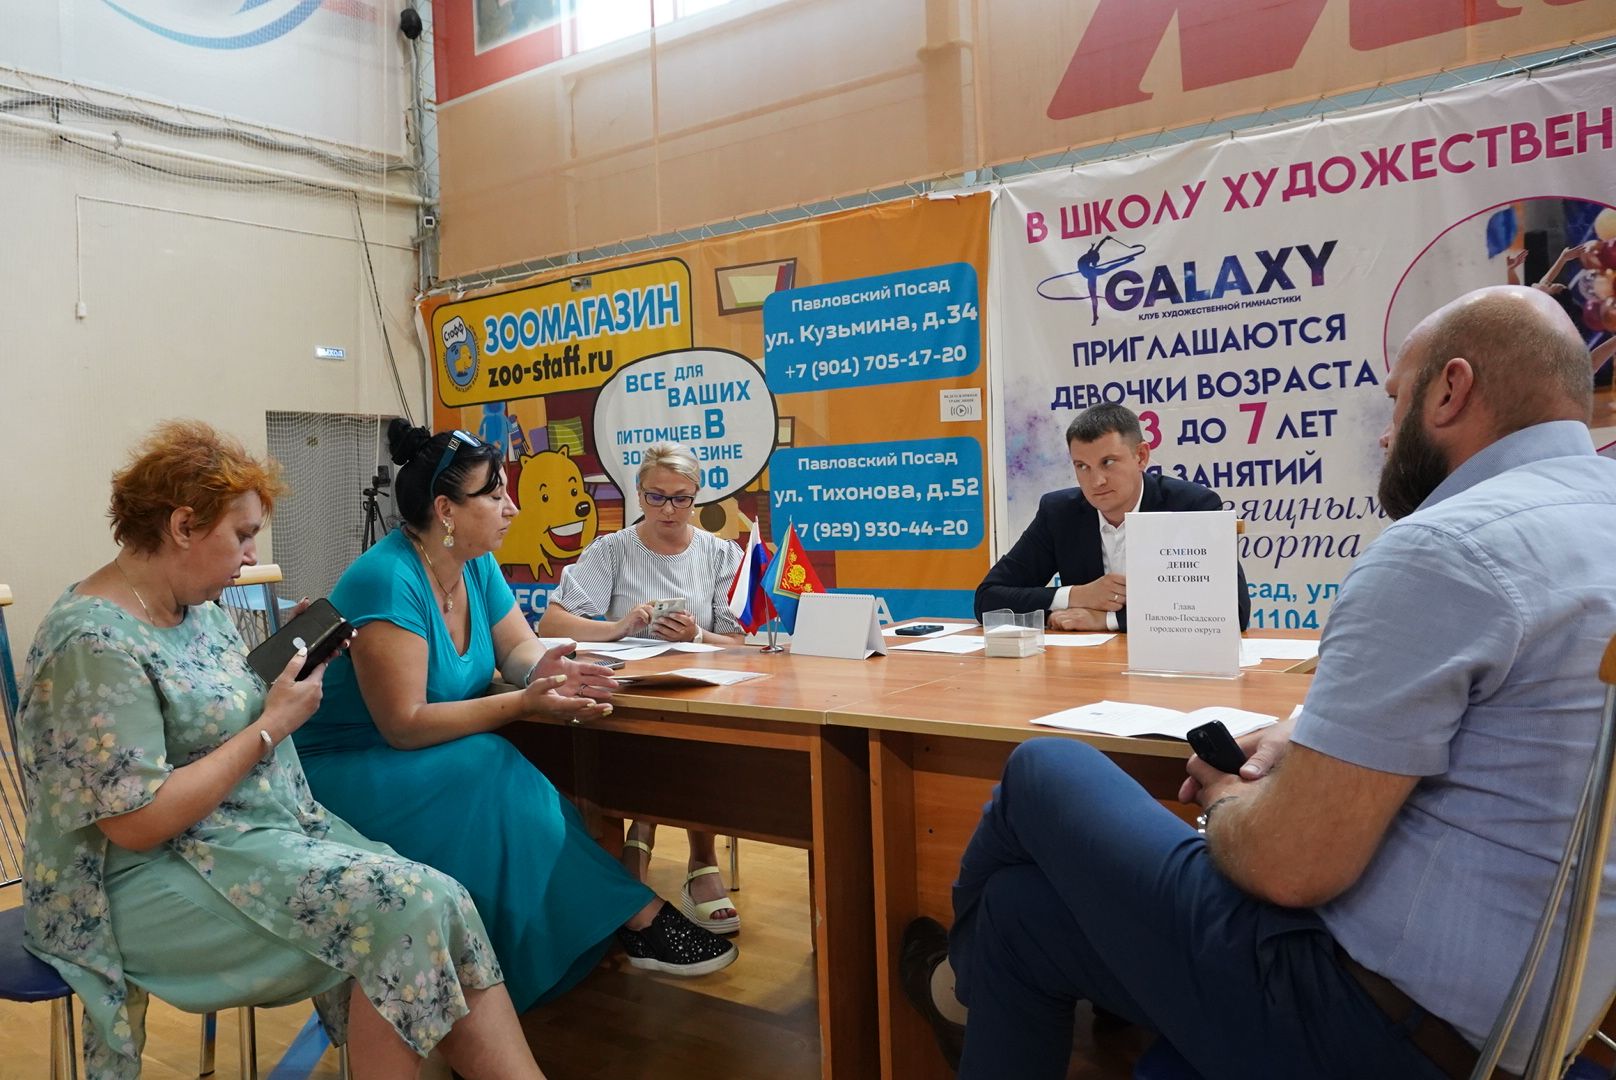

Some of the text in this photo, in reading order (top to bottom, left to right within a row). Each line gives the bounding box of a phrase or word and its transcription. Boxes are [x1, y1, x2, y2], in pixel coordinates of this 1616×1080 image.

[1026, 211, 1048, 244] В
[1059, 180, 1207, 240] ШКОЛУ
[1104, 239, 1339, 312] GALAXY
[791, 279, 951, 313] Павловский Посад
[1138, 295, 1302, 321] КЛУБ ХУДОЖЕСТВЕННОЙ ГИМНАСТИКИ
[483, 284, 681, 354] ЗООМАГАЗИН
[765, 302, 978, 352] ул. Кузьмина, д.34
[1072, 313, 1347, 368] ПРИГЛАШАЮТСЯ
[488, 344, 614, 388] zoo-staff.ru
[625, 364, 704, 393] ВСЕ ДЛЯ
[785, 345, 967, 381] +7 (901) 705-17-20
[667, 379, 751, 408] ВАШИХ
[1051, 359, 1380, 411] ДЕВОЧКИ ВОЗРАСТА
[616, 408, 726, 446] ПИТОМЦЕВ В
[1177, 417, 1227, 446] ДО
[1239, 401, 1268, 445] 7
[1275, 409, 1338, 439] ЛЕТ
[797, 451, 958, 471] Павловский Посад
[1173, 449, 1323, 488] ЗАНЯТИЙ
[774, 477, 979, 508] ул. Тихонова, д.52
[813, 521, 861, 542] (929)
[864, 519, 969, 538] 930-44-20
[1159, 547, 1208, 556] СЕМЕНОВ
[1166, 561, 1201, 570] ДЕНИС
[1157, 575, 1210, 583] ОЛЕГОВИЧ
[1145, 613, 1226, 623] Павлово-Посадского
[1173, 602, 1196, 611] Глава
[1149, 625, 1222, 637] городского округа
